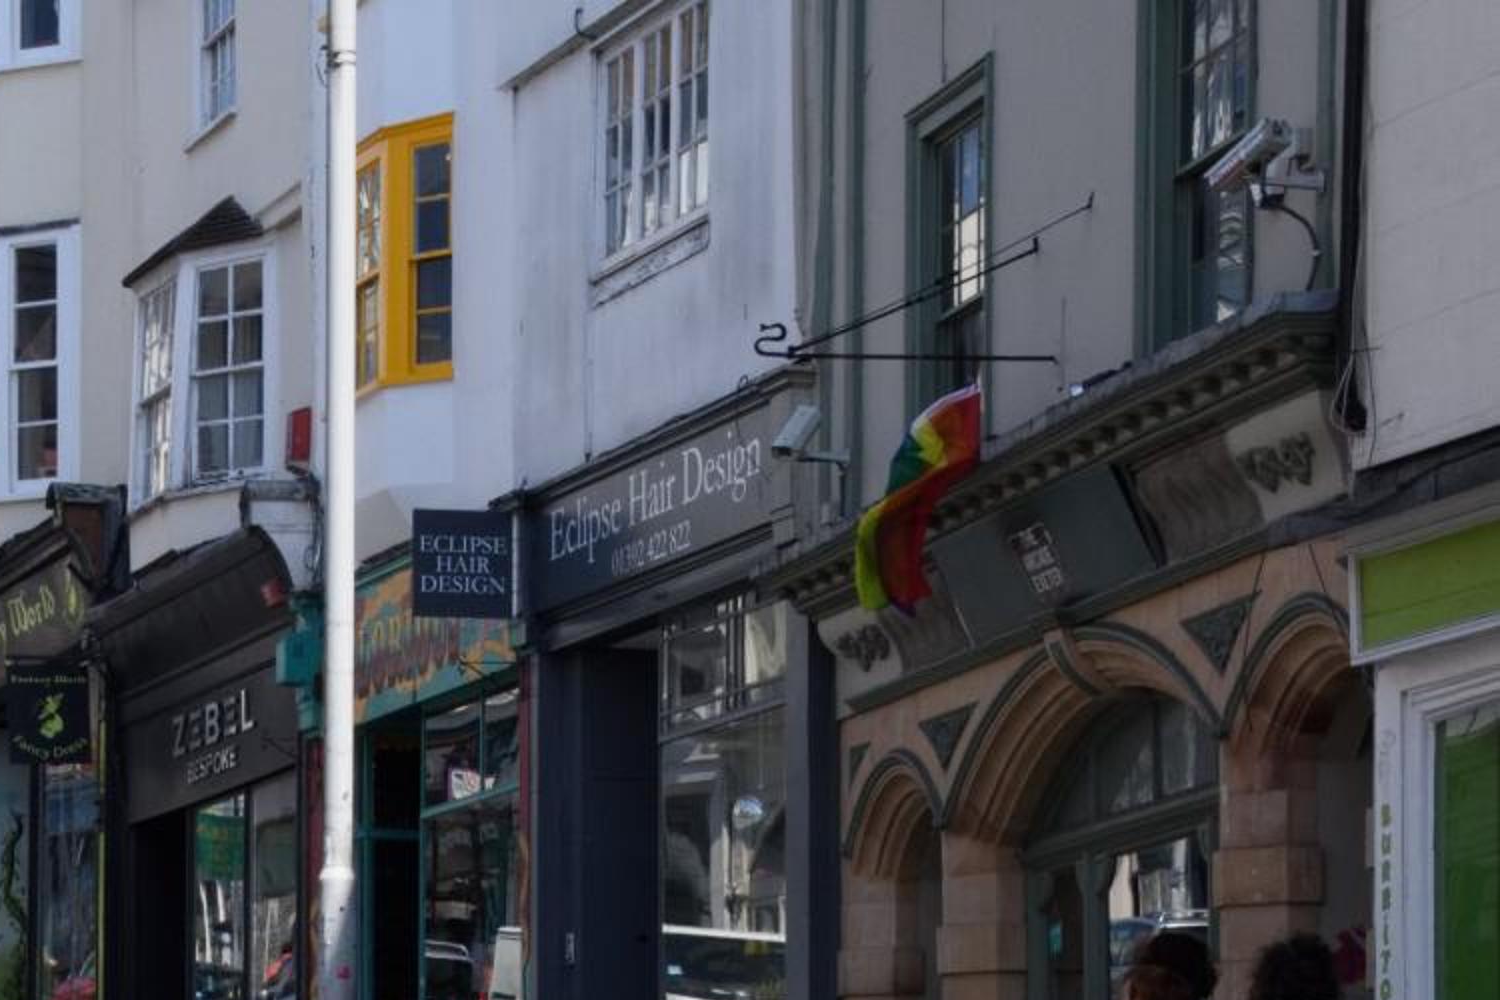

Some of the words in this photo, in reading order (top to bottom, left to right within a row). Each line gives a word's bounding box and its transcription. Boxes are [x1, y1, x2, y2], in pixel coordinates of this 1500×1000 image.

[550, 496, 621, 564] Eclipse
[628, 461, 676, 527] Hair
[682, 431, 761, 503] Design
[420, 535, 508, 554] ECLIPSE
[436, 555, 490, 574] HAIR
[420, 575, 505, 594] DESIGN
[172, 689, 255, 759] ZEBEL
[186, 745, 238, 784] BESPOKE
